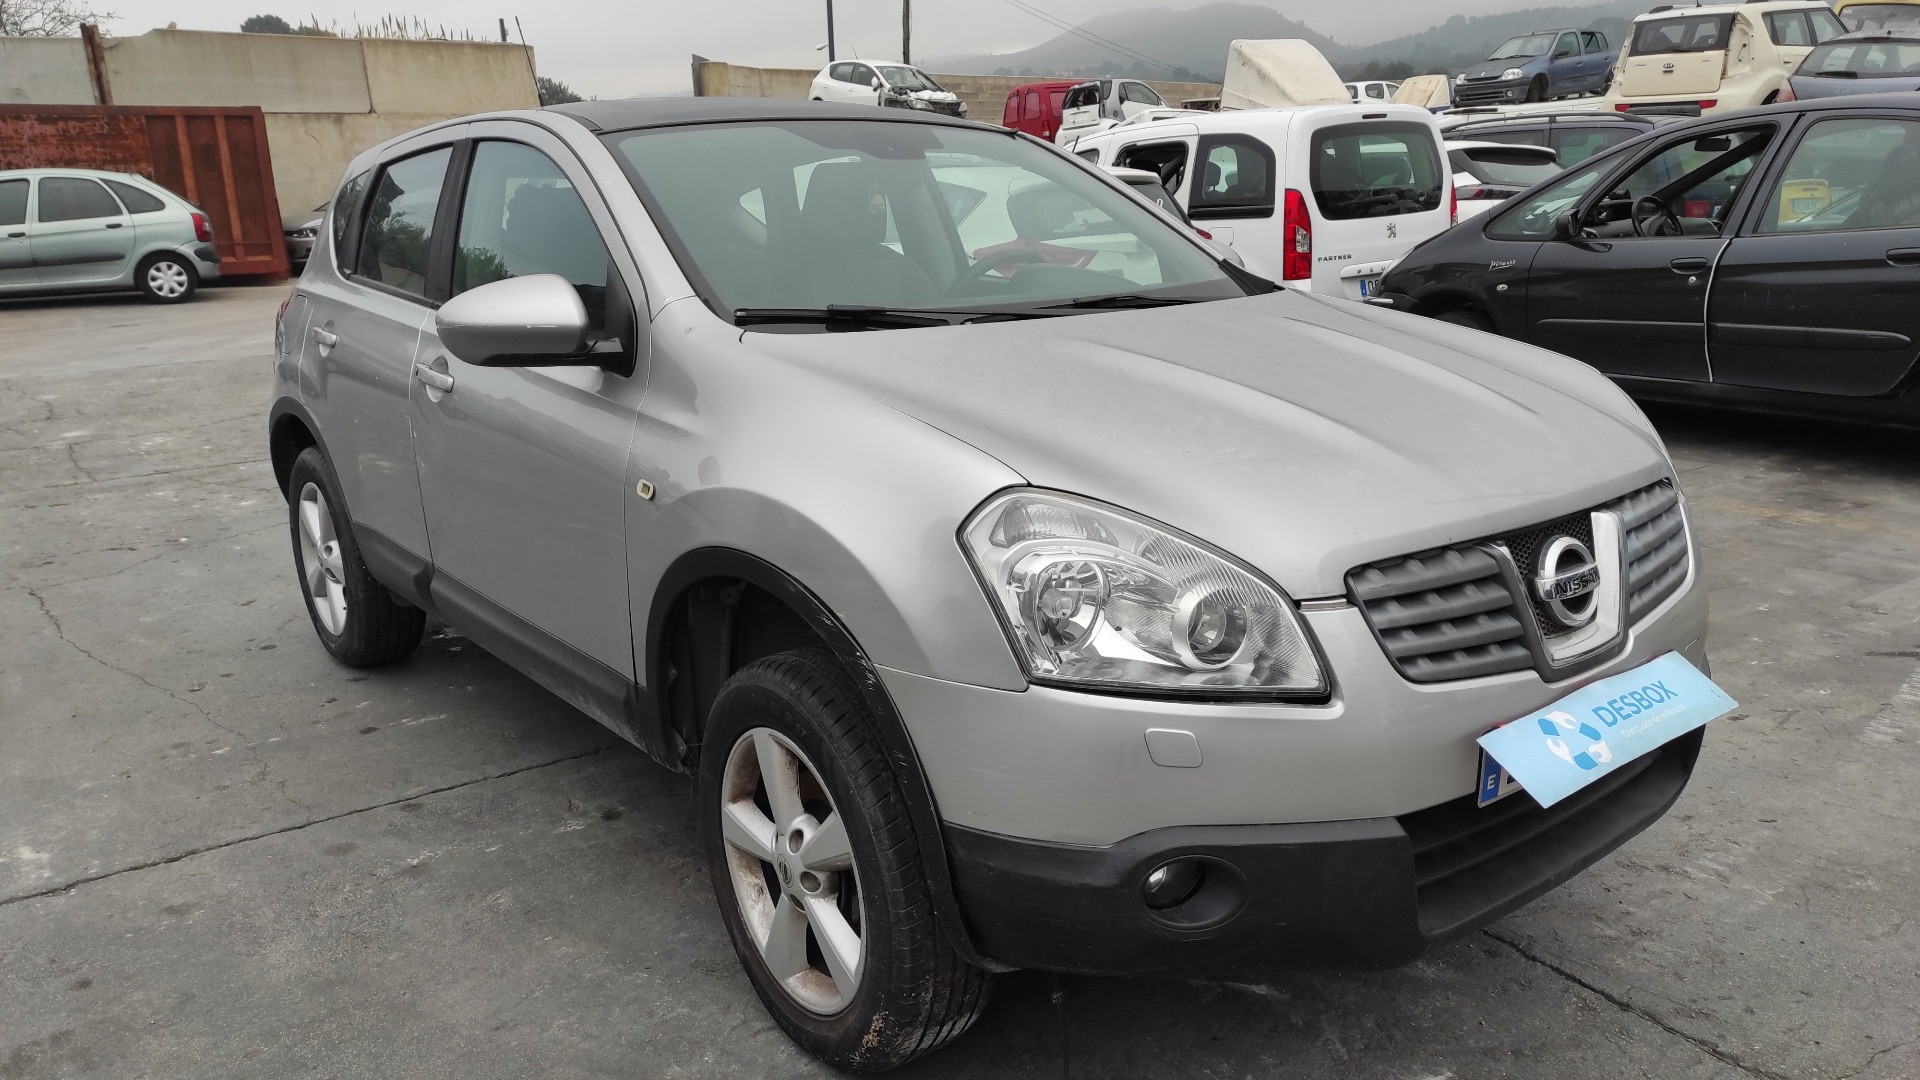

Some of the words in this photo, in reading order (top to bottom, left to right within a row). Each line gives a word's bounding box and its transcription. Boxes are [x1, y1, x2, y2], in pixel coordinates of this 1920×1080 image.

[1318, 254, 1352, 262] PARTNER
[1357, 266, 1386, 274] PEU
[1591, 680, 1678, 727] DESBOX
[1621, 719, 1653, 737] Desguace
[1652, 714, 1661, 723] de
[1487, 774, 1496, 790] E
